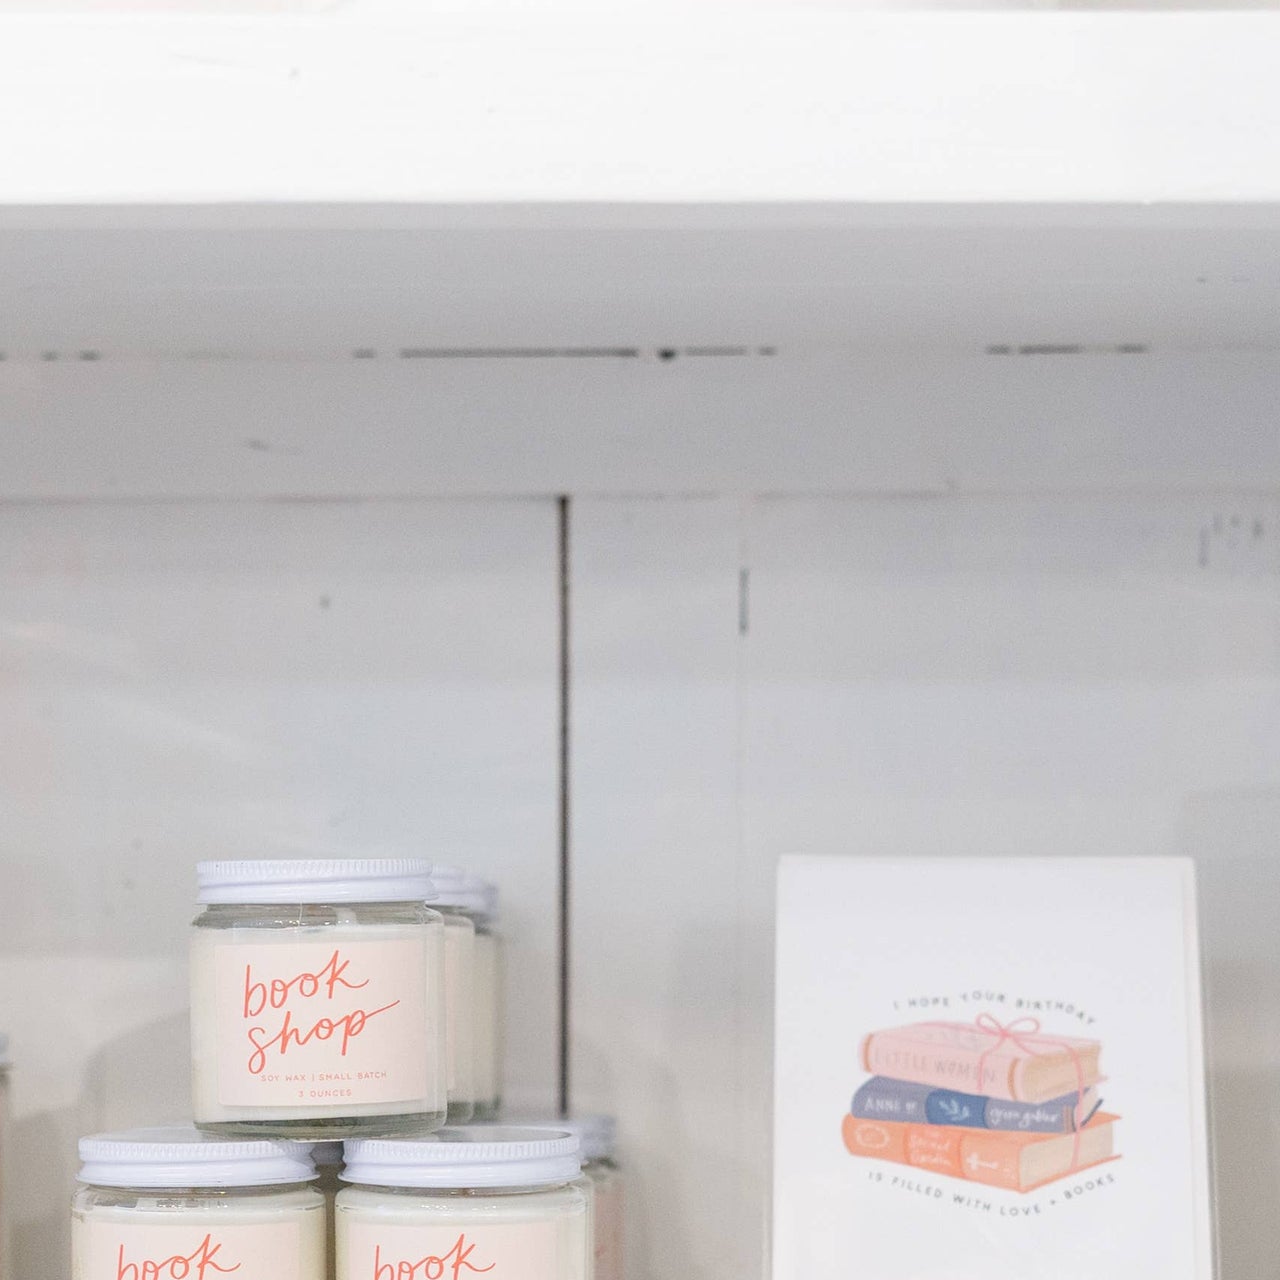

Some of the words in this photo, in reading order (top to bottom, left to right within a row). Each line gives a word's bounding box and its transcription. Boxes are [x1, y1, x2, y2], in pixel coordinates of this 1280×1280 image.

[243, 950, 368, 1019] book
[908, 996, 950, 1008] HOPE
[960, 990, 1006, 1003] YOUR
[1016, 998, 1096, 1025] BIRTHDAY
[247, 1000, 400, 1074] shop
[260, 1074, 280, 1082] SOY
[285, 1074, 306, 1082] WAX
[319, 1073, 352, 1081] SMALL
[357, 1071, 387, 1080] BATCH
[298, 1090, 304, 1098] 3
[309, 1088, 353, 1098] OUNCES
[891, 1176, 944, 1199] FILLED
[952, 1194, 992, 1211] WITH
[999, 1204, 1042, 1217] LOVE
[1063, 1173, 1115, 1200] BOOKS
